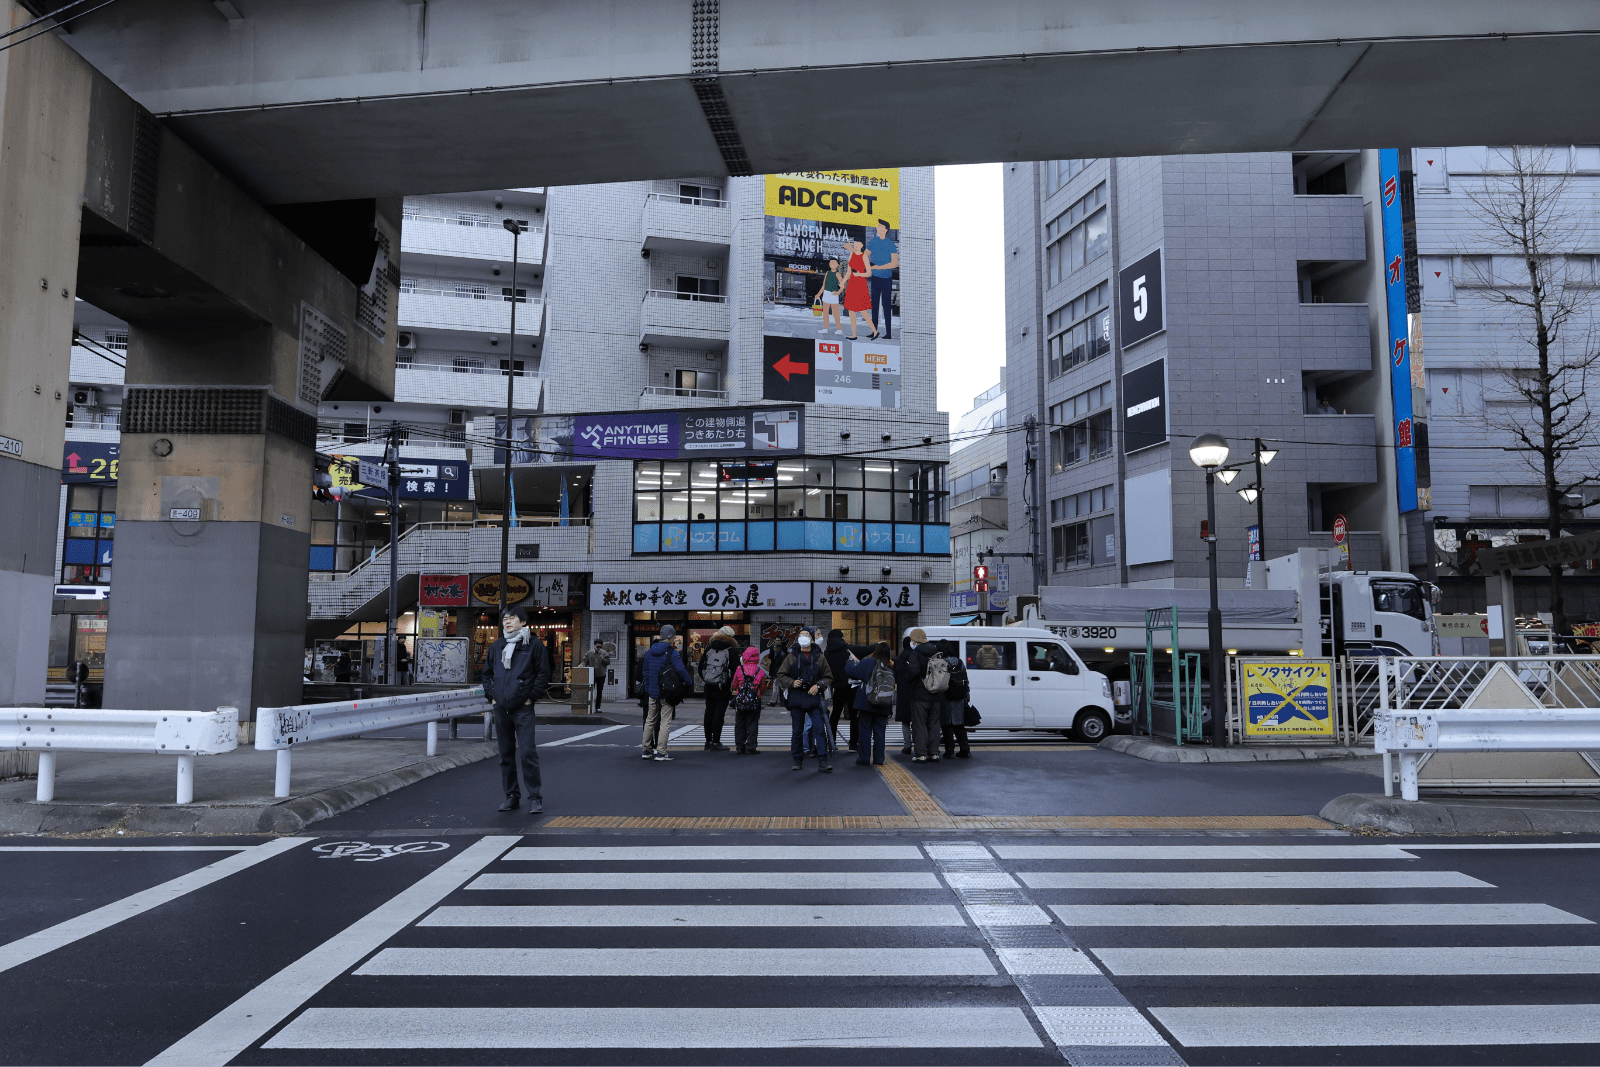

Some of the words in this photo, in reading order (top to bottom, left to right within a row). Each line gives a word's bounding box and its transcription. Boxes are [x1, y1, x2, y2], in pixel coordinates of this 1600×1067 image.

[778, 185, 878, 215] ADCAST
[778, 235, 823, 253] BRANCH
[1132, 275, 1148, 322] 5
[866, 355, 886, 364] HERE
[834, 375, 851, 384] 246
[685, 416, 746, 428] この建物側道
[604, 423, 669, 435] ANYTIME
[685, 428, 746, 440] つきあたり右
[603, 434, 669, 446] FITNESS
[109, 446, 120, 455] こ
[683, 531, 741, 543] ハウスコム
[858, 531, 916, 543] ハウスコム
[422, 582, 466, 599] 村さ来
[602, 586, 688, 606] 熱烈中華食堂
[701, 583, 764, 608] 日高屋
[856, 586, 914, 608] 日高屋
[1081, 626, 1117, 639] 3920
[1247, 666, 1327, 678] レンタサイクル
